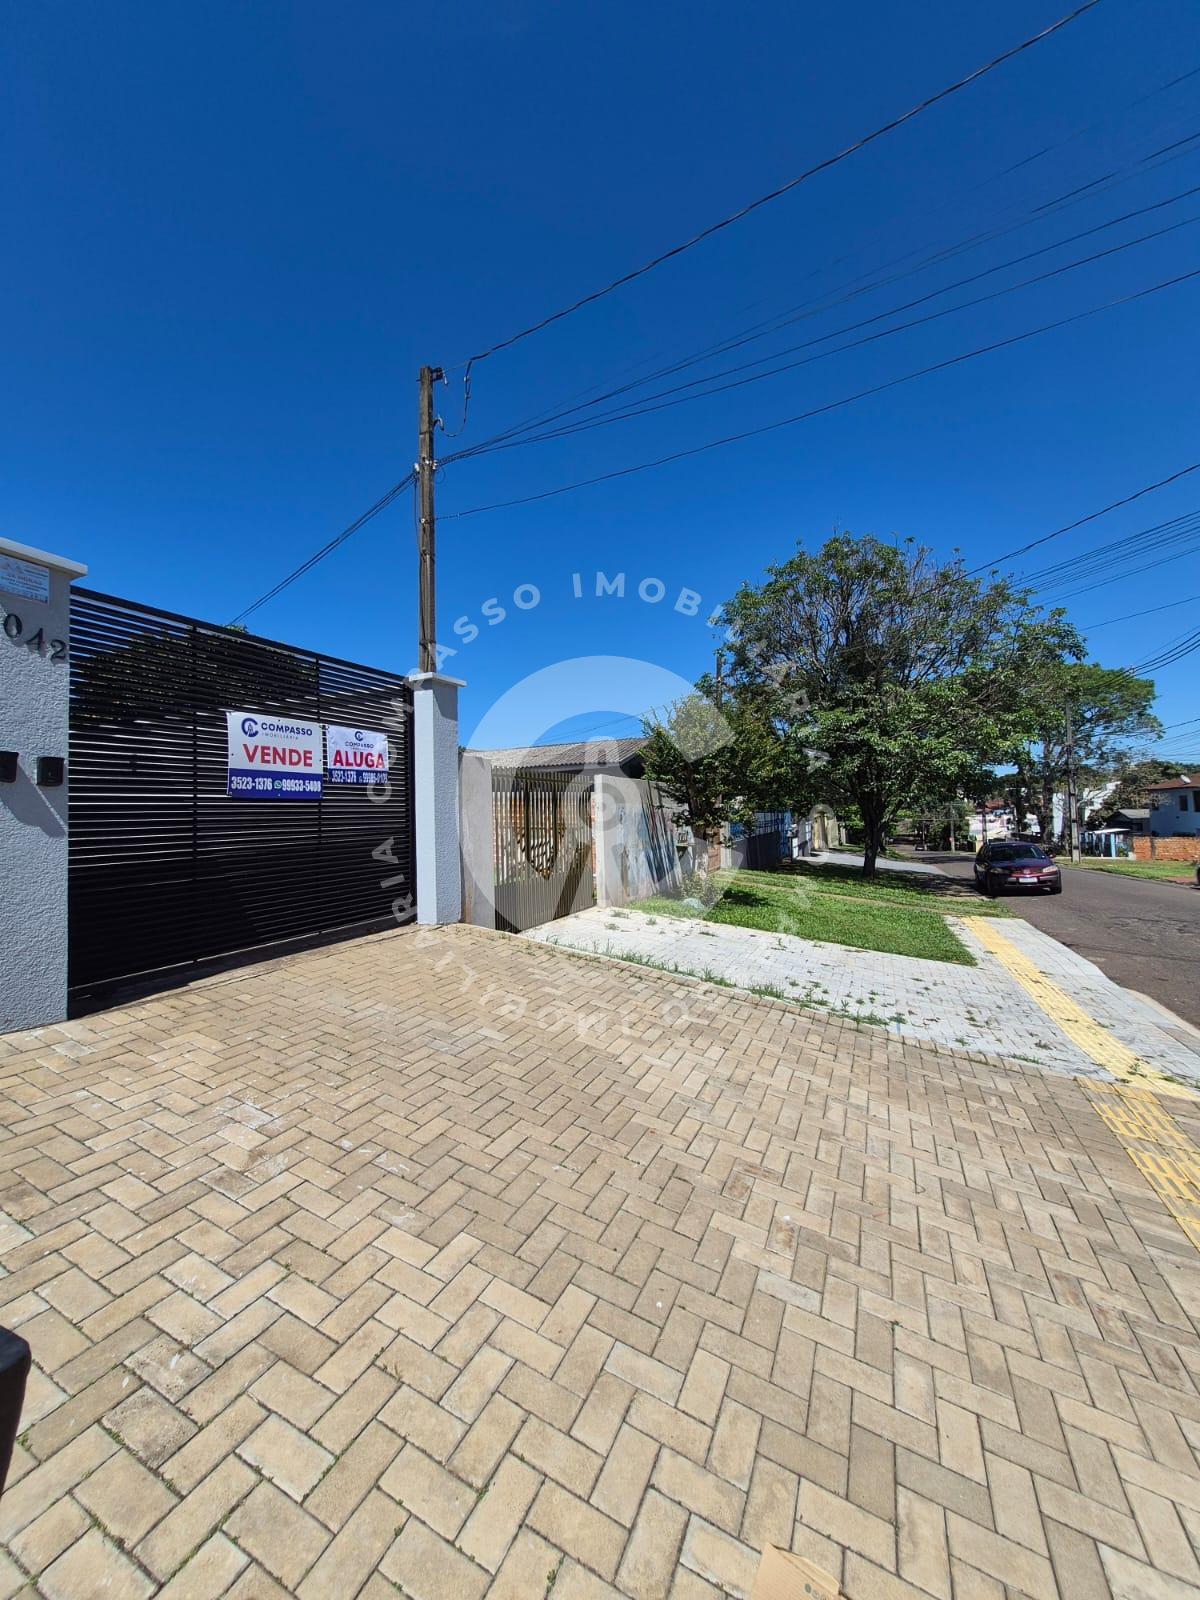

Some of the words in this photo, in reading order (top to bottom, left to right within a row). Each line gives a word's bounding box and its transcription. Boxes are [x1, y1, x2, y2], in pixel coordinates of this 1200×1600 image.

[261, 722, 313, 736] COMPASSO
[243, 743, 313, 767] VENDE
[333, 750, 385, 769] ALUGA
[231, 776, 273, 791] 3523-1376
